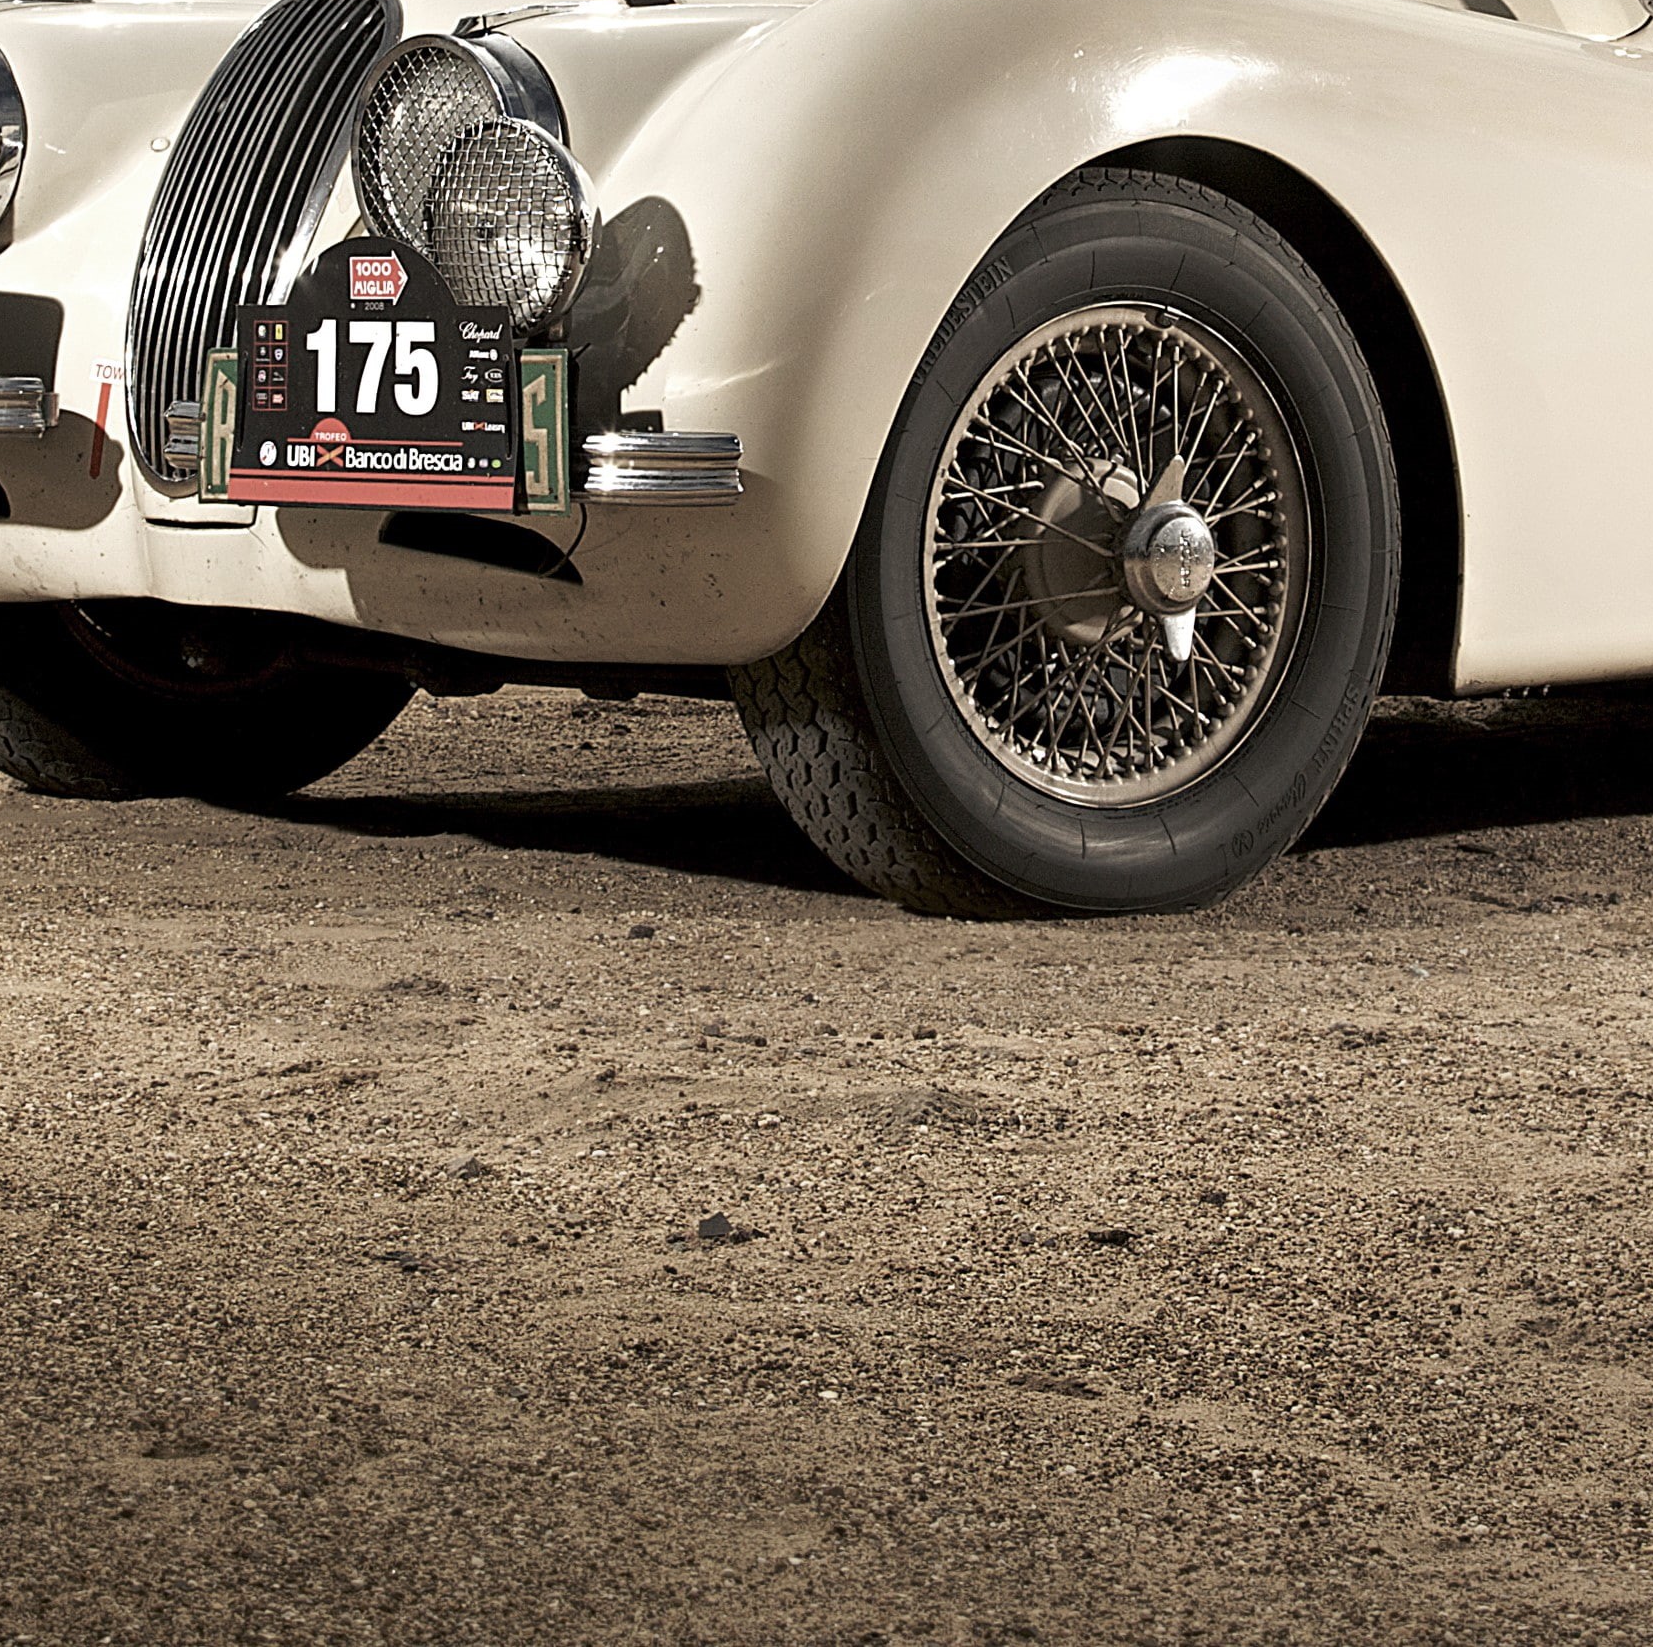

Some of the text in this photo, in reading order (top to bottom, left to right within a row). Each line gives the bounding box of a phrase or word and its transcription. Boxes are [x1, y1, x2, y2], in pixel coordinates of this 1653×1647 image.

[356, 261, 392, 277] 1000
[353, 280, 395, 295] MIGLIA
[458, 321, 503, 343] Chopard
[306, 319, 439, 416] 175
[315, 432, 347, 442] TROFEO
[286, 444, 462, 472] UBI Banco di Brescia
[1313, 683, 1361, 774] SPRINT
